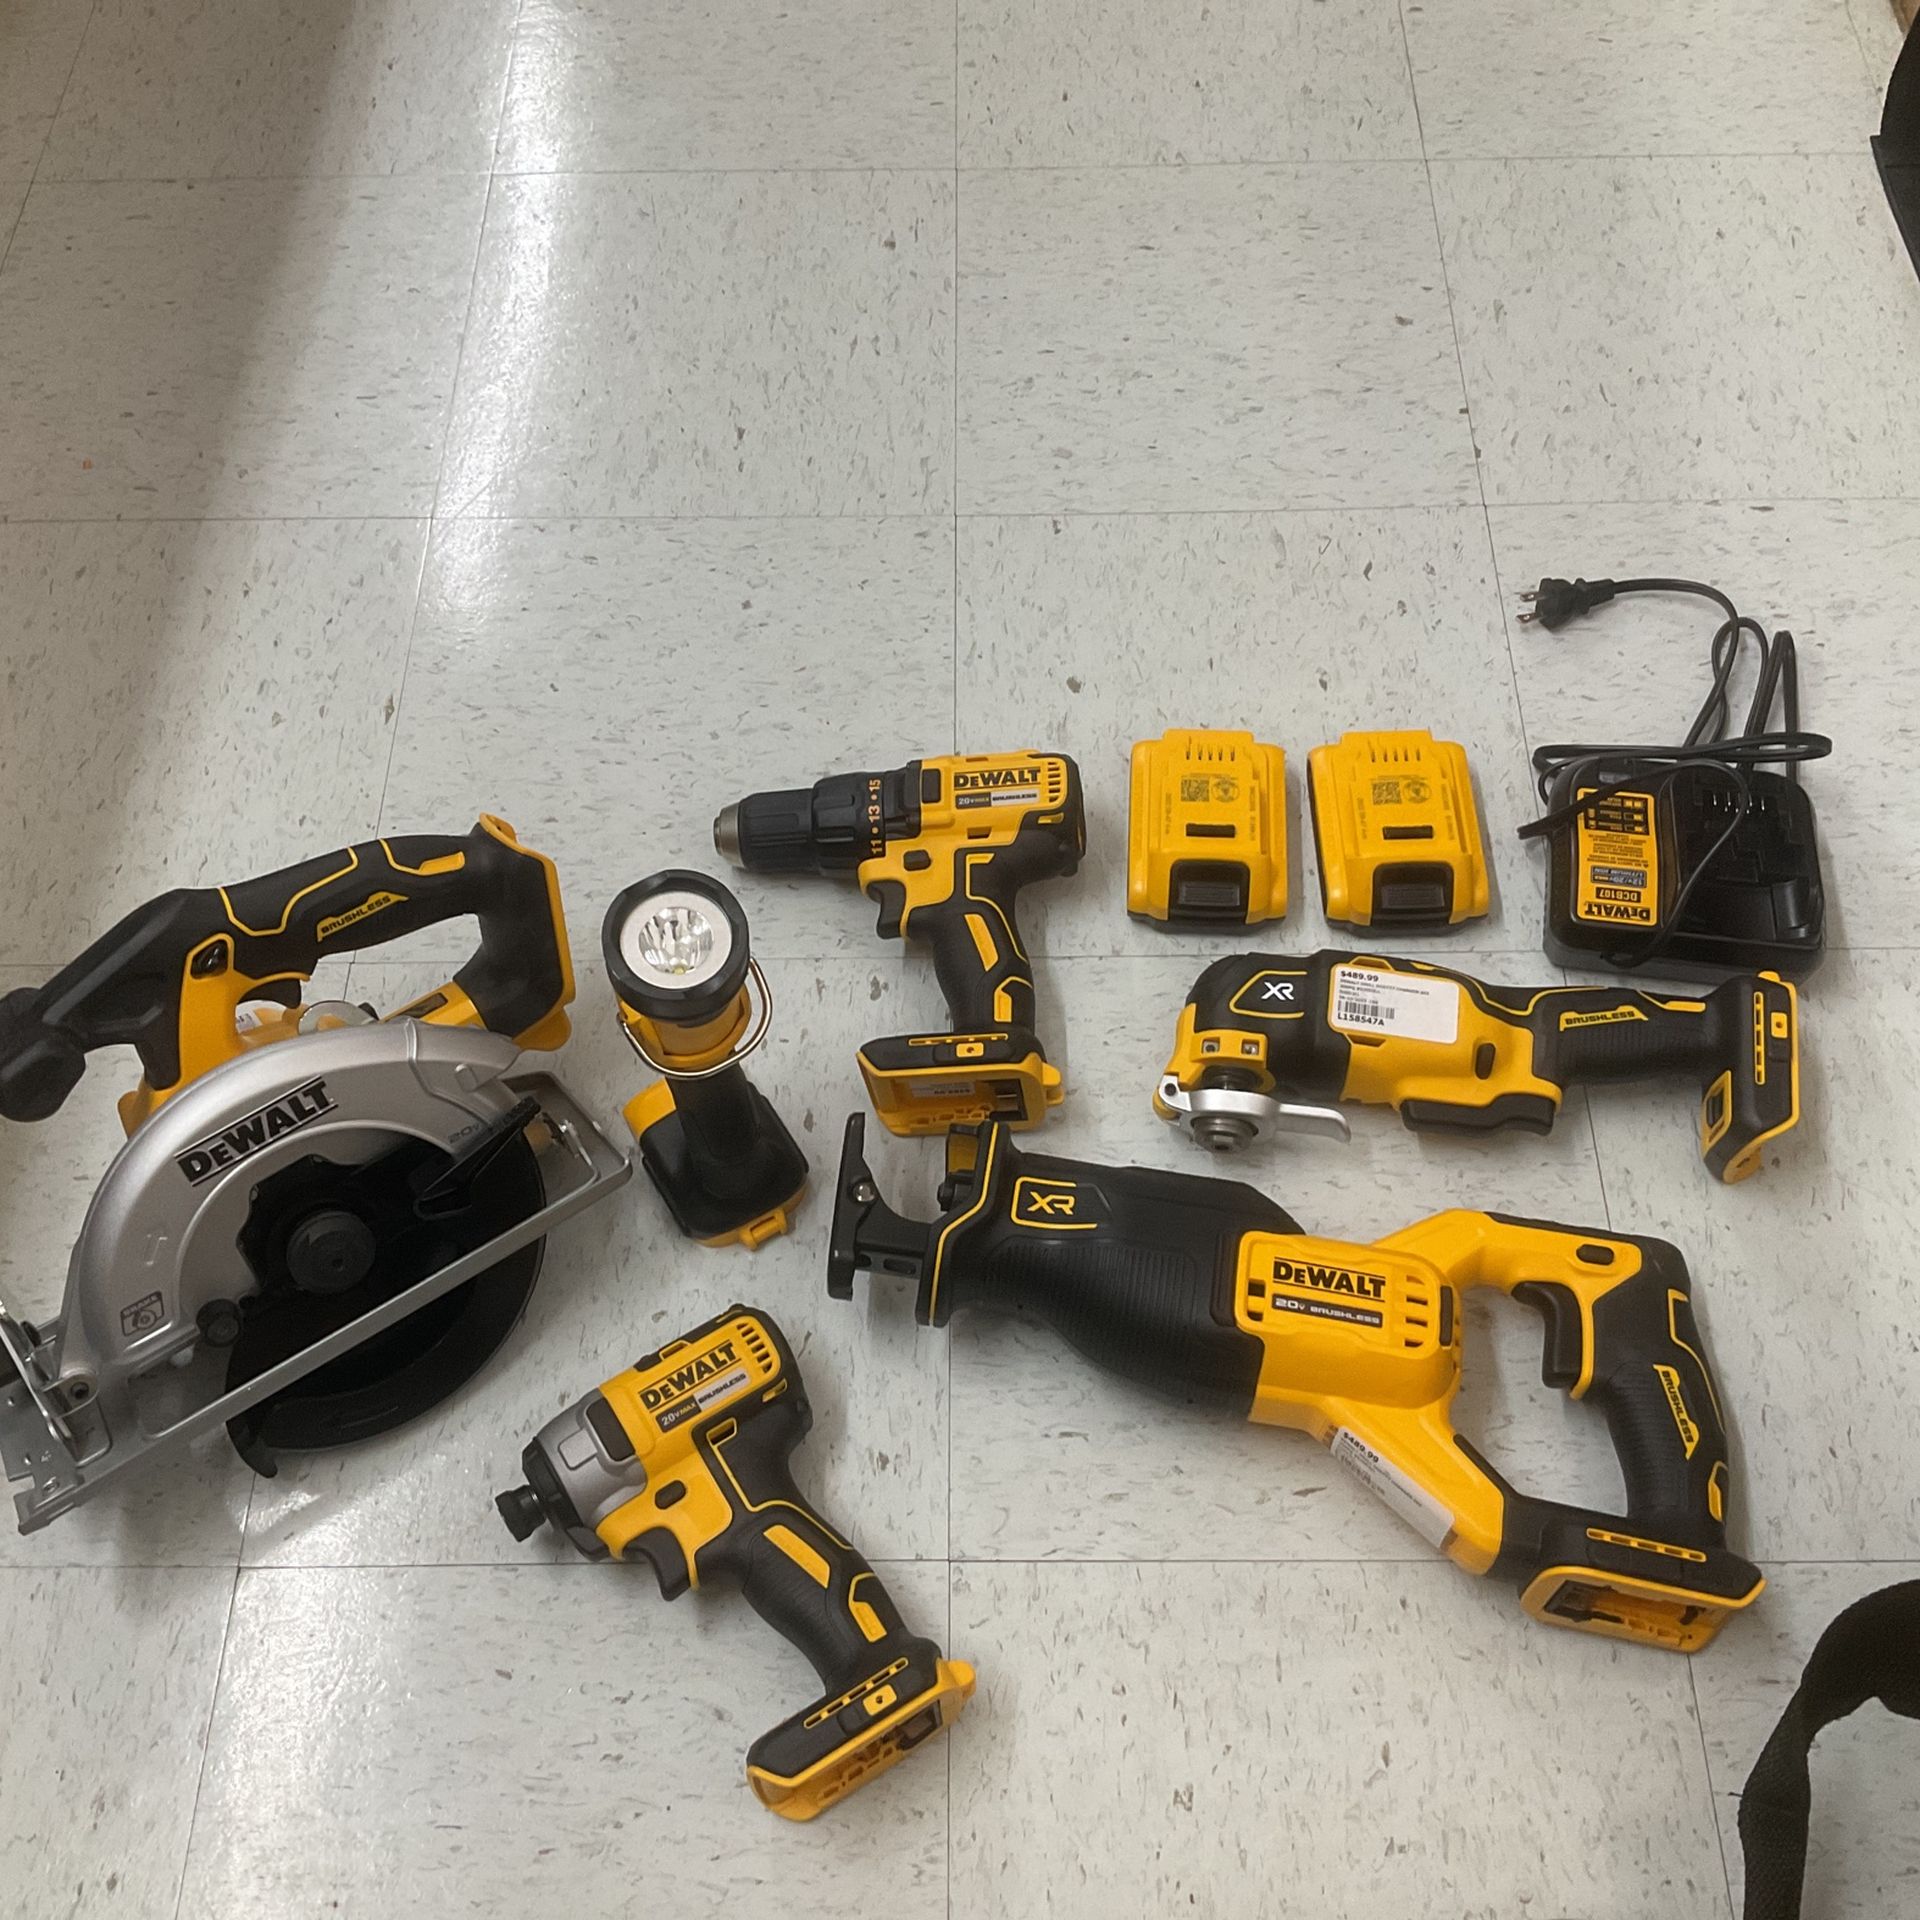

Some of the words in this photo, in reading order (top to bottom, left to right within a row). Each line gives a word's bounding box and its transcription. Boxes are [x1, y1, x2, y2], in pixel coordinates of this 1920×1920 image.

[869, 778, 882, 792] 15
[868, 805, 881, 823] 13
[1599, 890, 1638, 901] DCB107
[320, 895, 391, 934] BRUSHLESS
[1340, 970, 1379, 982] $489.99
[1260, 981, 1295, 1001] XR
[1337, 1012, 1385, 1026] L158547A
[1564, 1010, 1635, 1025] BRUSHLESS
[1026, 1191, 1075, 1215] XR
[1310, 1305, 1380, 1324] BRUSHLESS
[697, 1372, 747, 1404] BRUSHLESS
[1661, 1370, 1694, 1443] BRUSHLESS
[1343, 1432, 1379, 1463] $489.99
